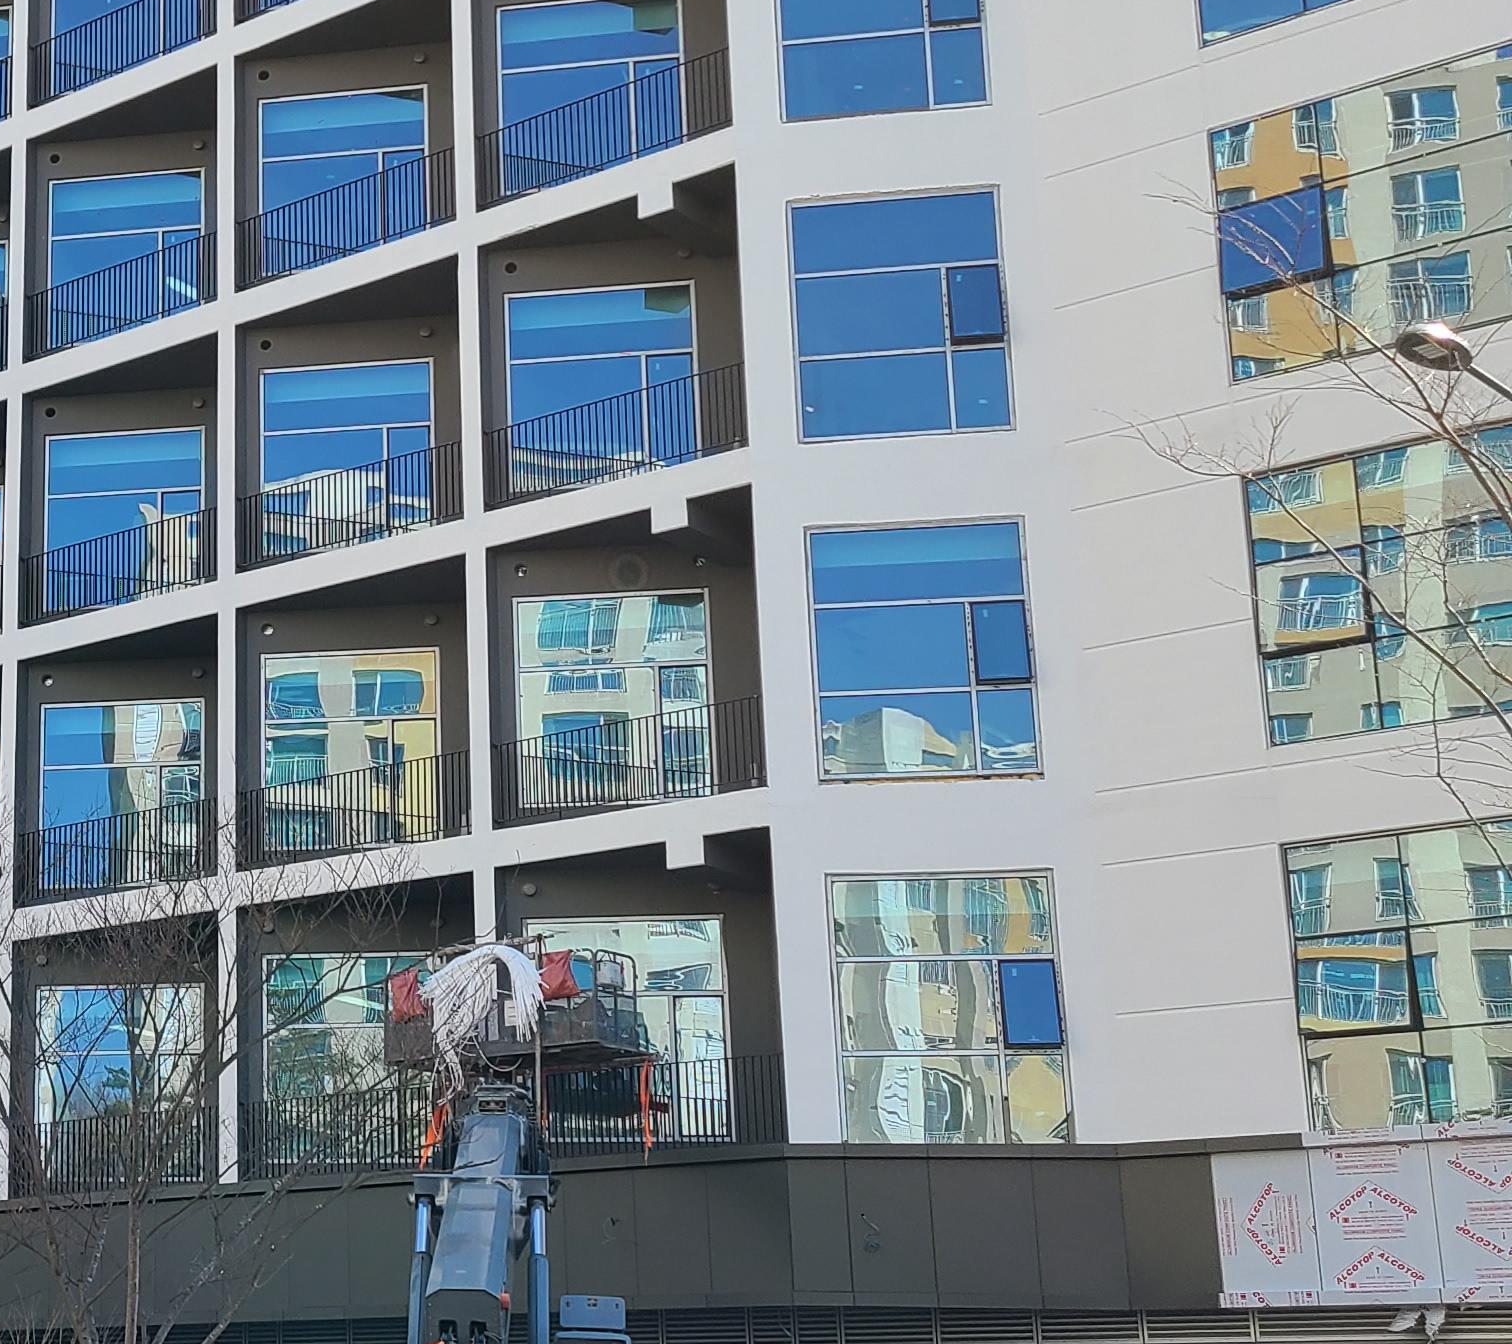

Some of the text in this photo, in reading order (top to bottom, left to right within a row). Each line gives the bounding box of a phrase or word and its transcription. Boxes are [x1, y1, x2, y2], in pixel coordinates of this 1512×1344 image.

[1447, 1159, 1496, 1187] ALCOTOP
[1246, 1182, 1273, 1225] ALCOTOP
[1329, 1185, 1367, 1220] ALCOTOP
[1369, 1186, 1418, 1215] ALCOTOP
[1246, 1227, 1282, 1266] ALCOTOP
[1455, 1225, 1505, 1254] ALCOTOP
[1336, 1251, 1374, 1285] ALCOTOP
[1377, 1252, 1425, 1281] ALCOTOP
